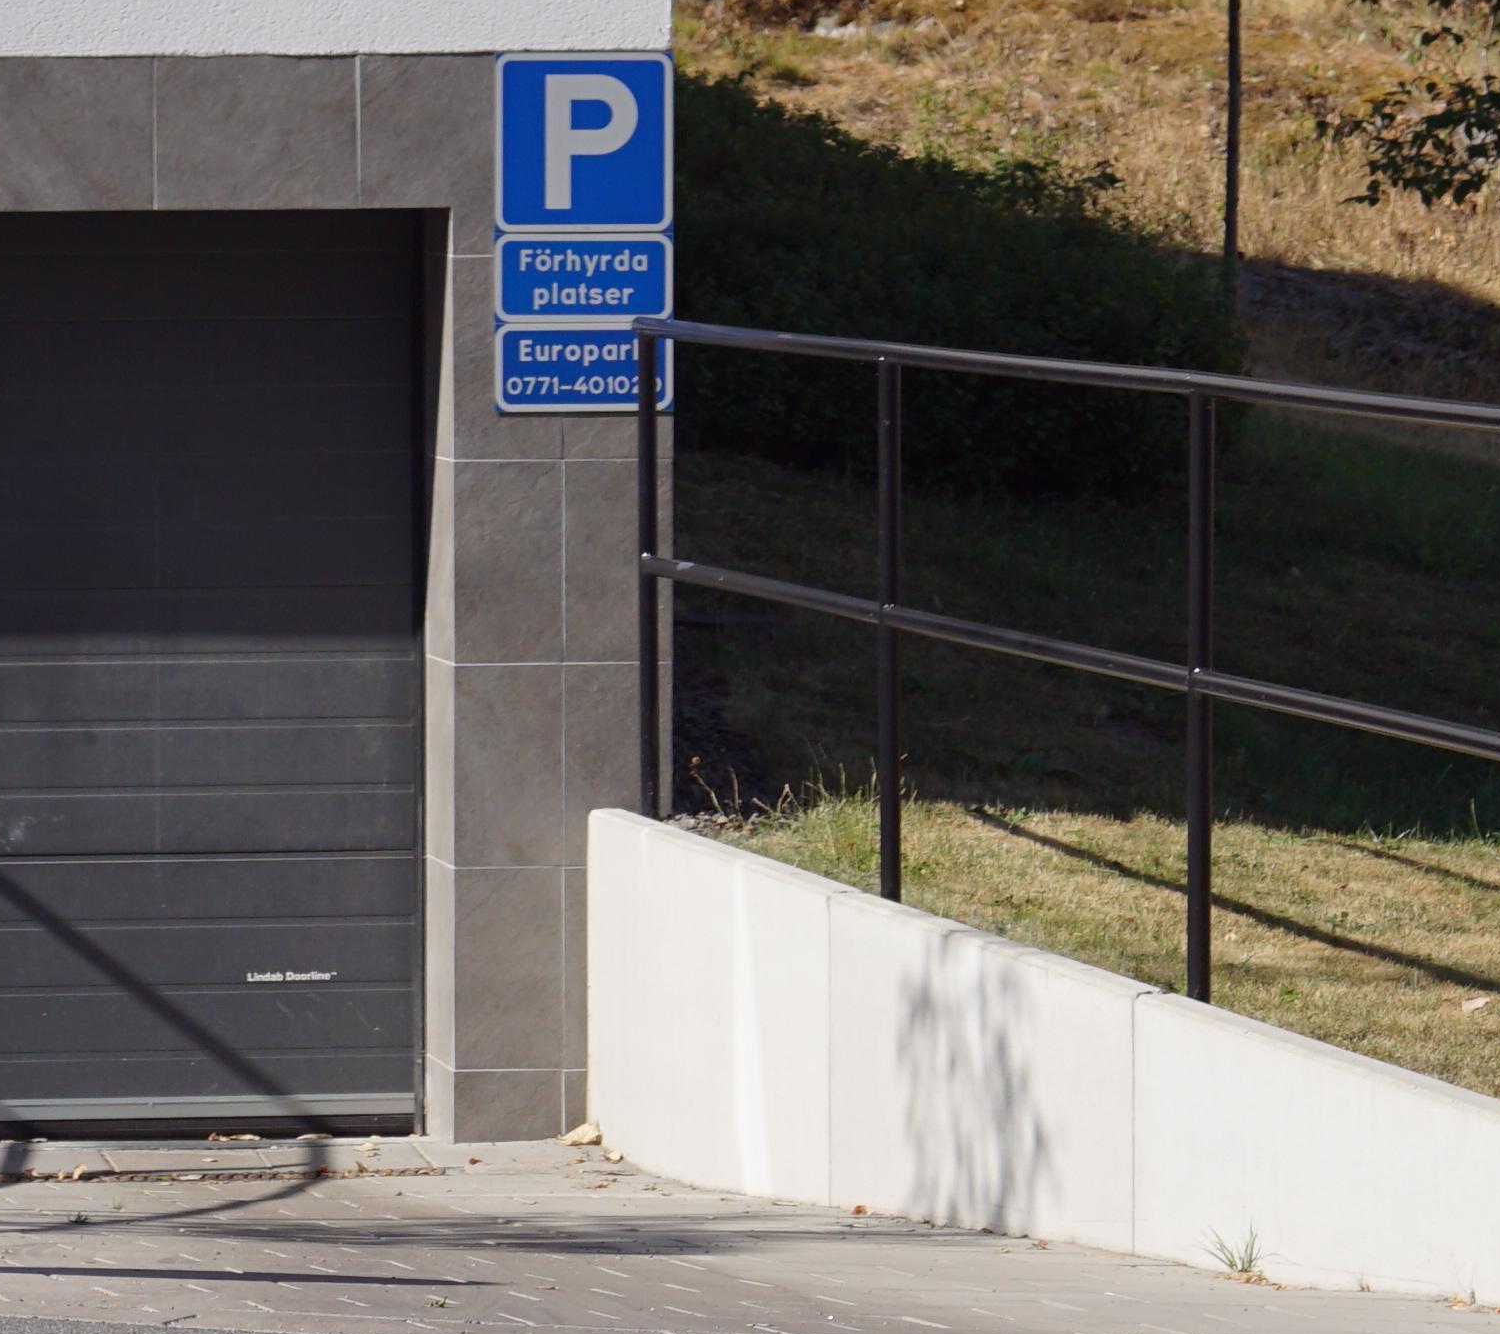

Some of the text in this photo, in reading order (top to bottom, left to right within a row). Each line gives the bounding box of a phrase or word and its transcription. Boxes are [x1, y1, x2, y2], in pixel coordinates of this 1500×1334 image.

[544, 73, 638, 209] P
[519, 249, 648, 277] Förhyrda
[533, 283, 634, 310] platser
